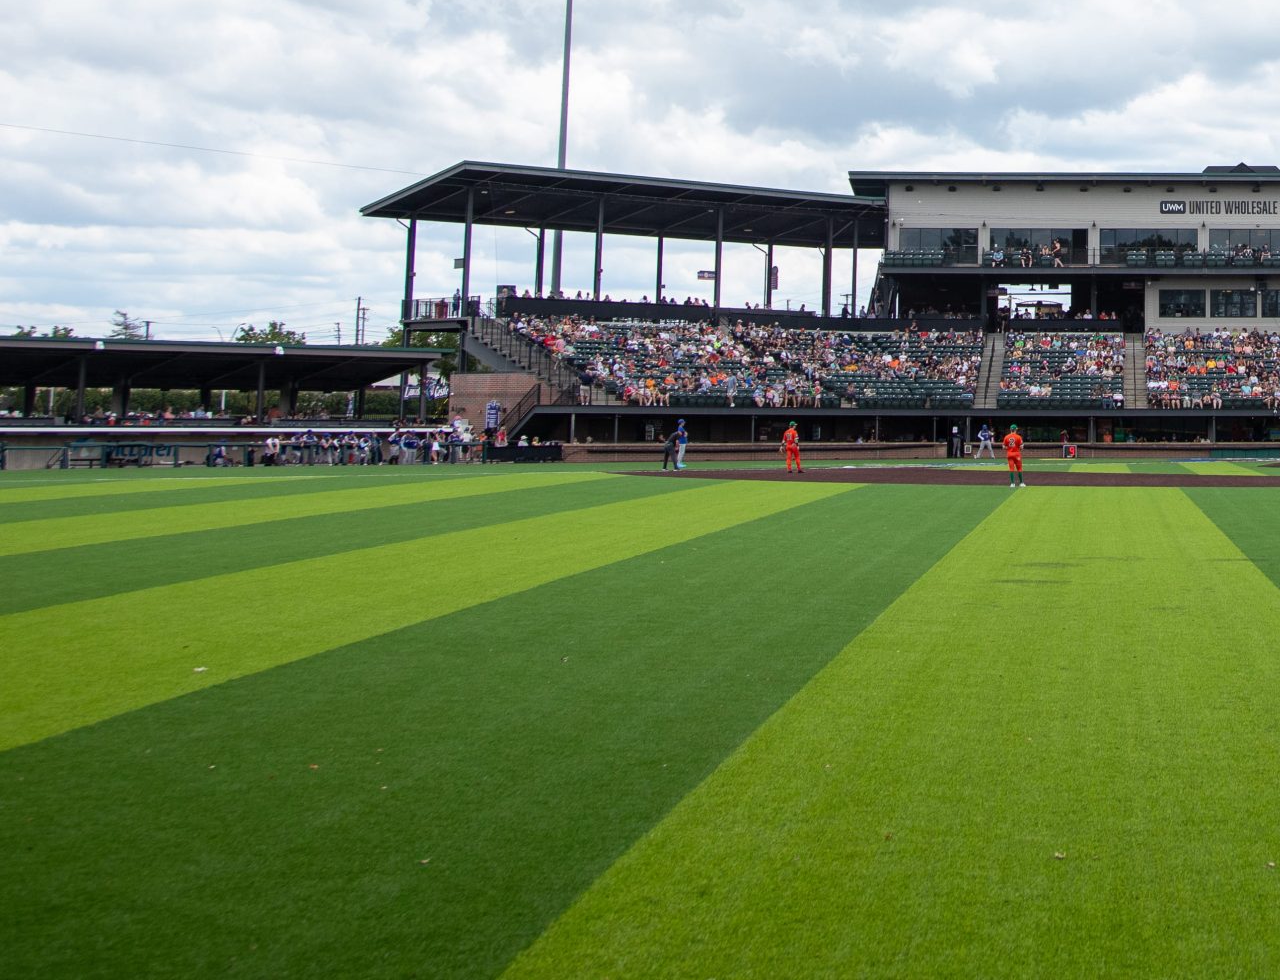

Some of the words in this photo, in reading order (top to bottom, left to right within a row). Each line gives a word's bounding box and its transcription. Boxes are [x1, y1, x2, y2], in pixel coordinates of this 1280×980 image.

[1162, 203, 1184, 212] UWM
[1189, 200, 1221, 215] UNITED
[1224, 200, 1278, 215] WHOLESALE
[1008, 437, 1016, 447] 2
